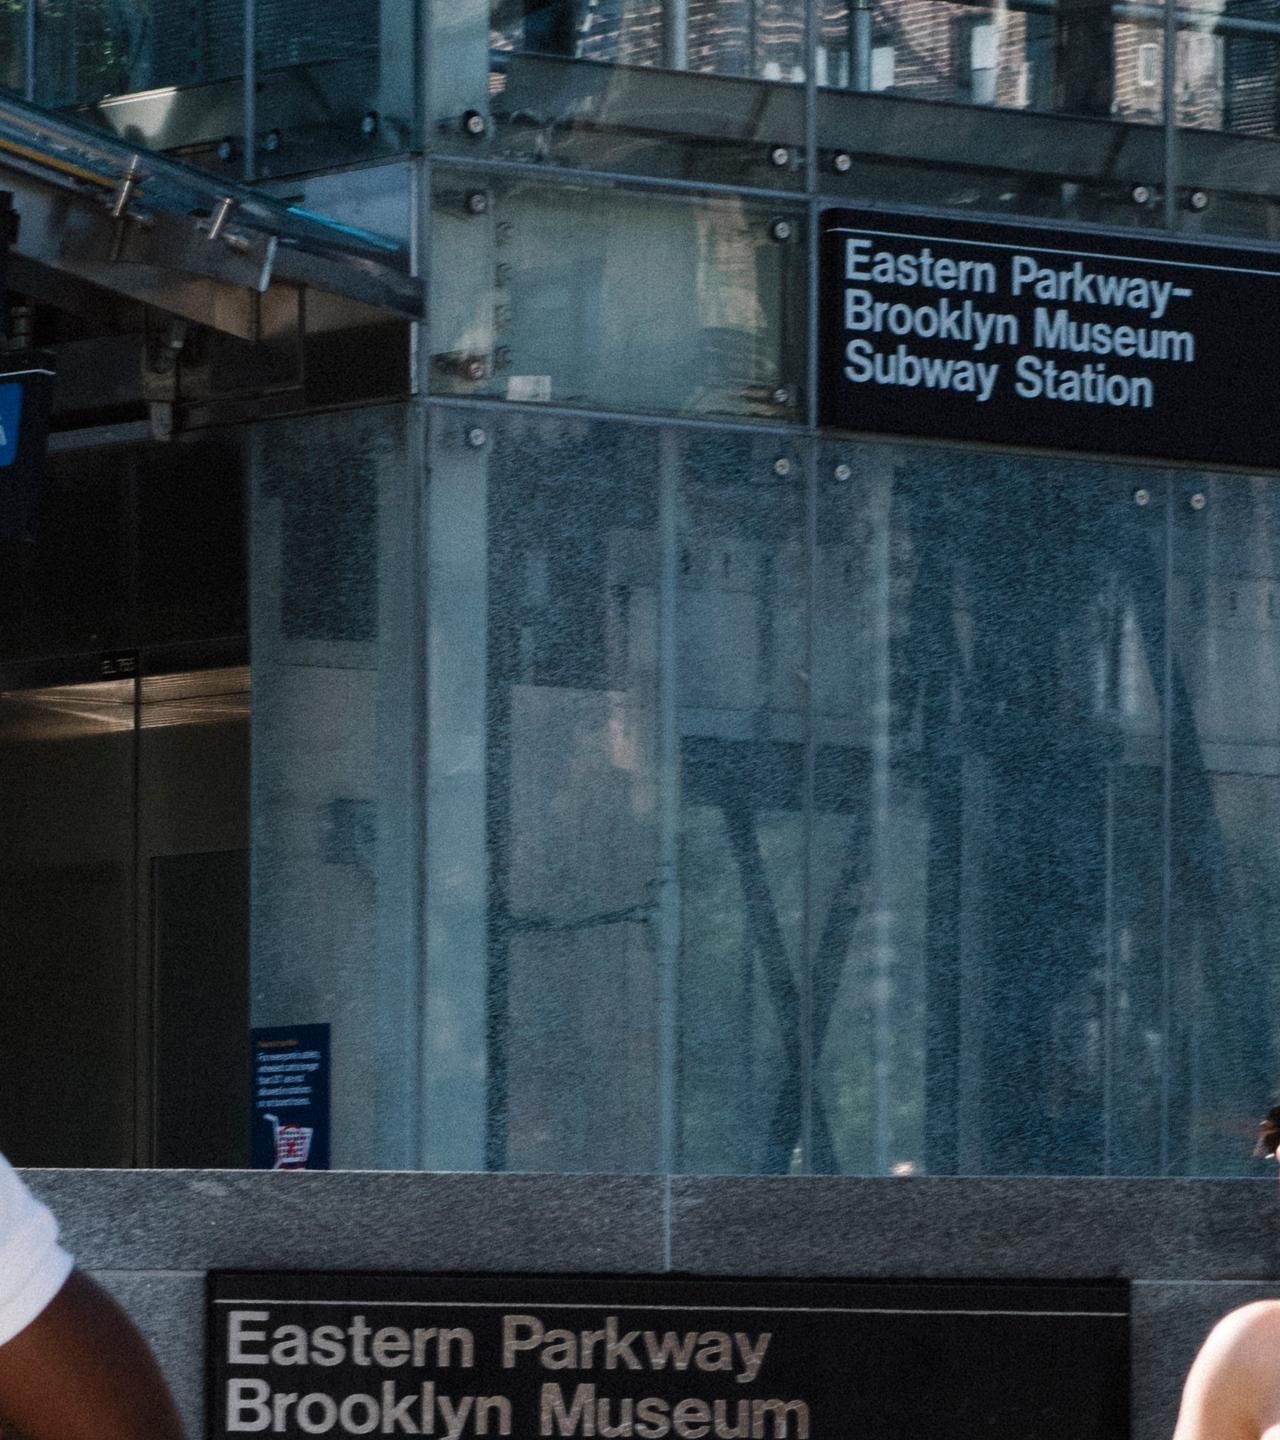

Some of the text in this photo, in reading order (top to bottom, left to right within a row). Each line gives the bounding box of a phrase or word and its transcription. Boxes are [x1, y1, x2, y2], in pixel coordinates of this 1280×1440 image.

[845, 238, 996, 293] Eastern
[844, 288, 1195, 362] Brooklyn Museum
[844, 338, 1154, 408] Subway Station
[226, 1310, 772, 1384] Eastern Parkway
[540, 1382, 811, 1440] Museum
